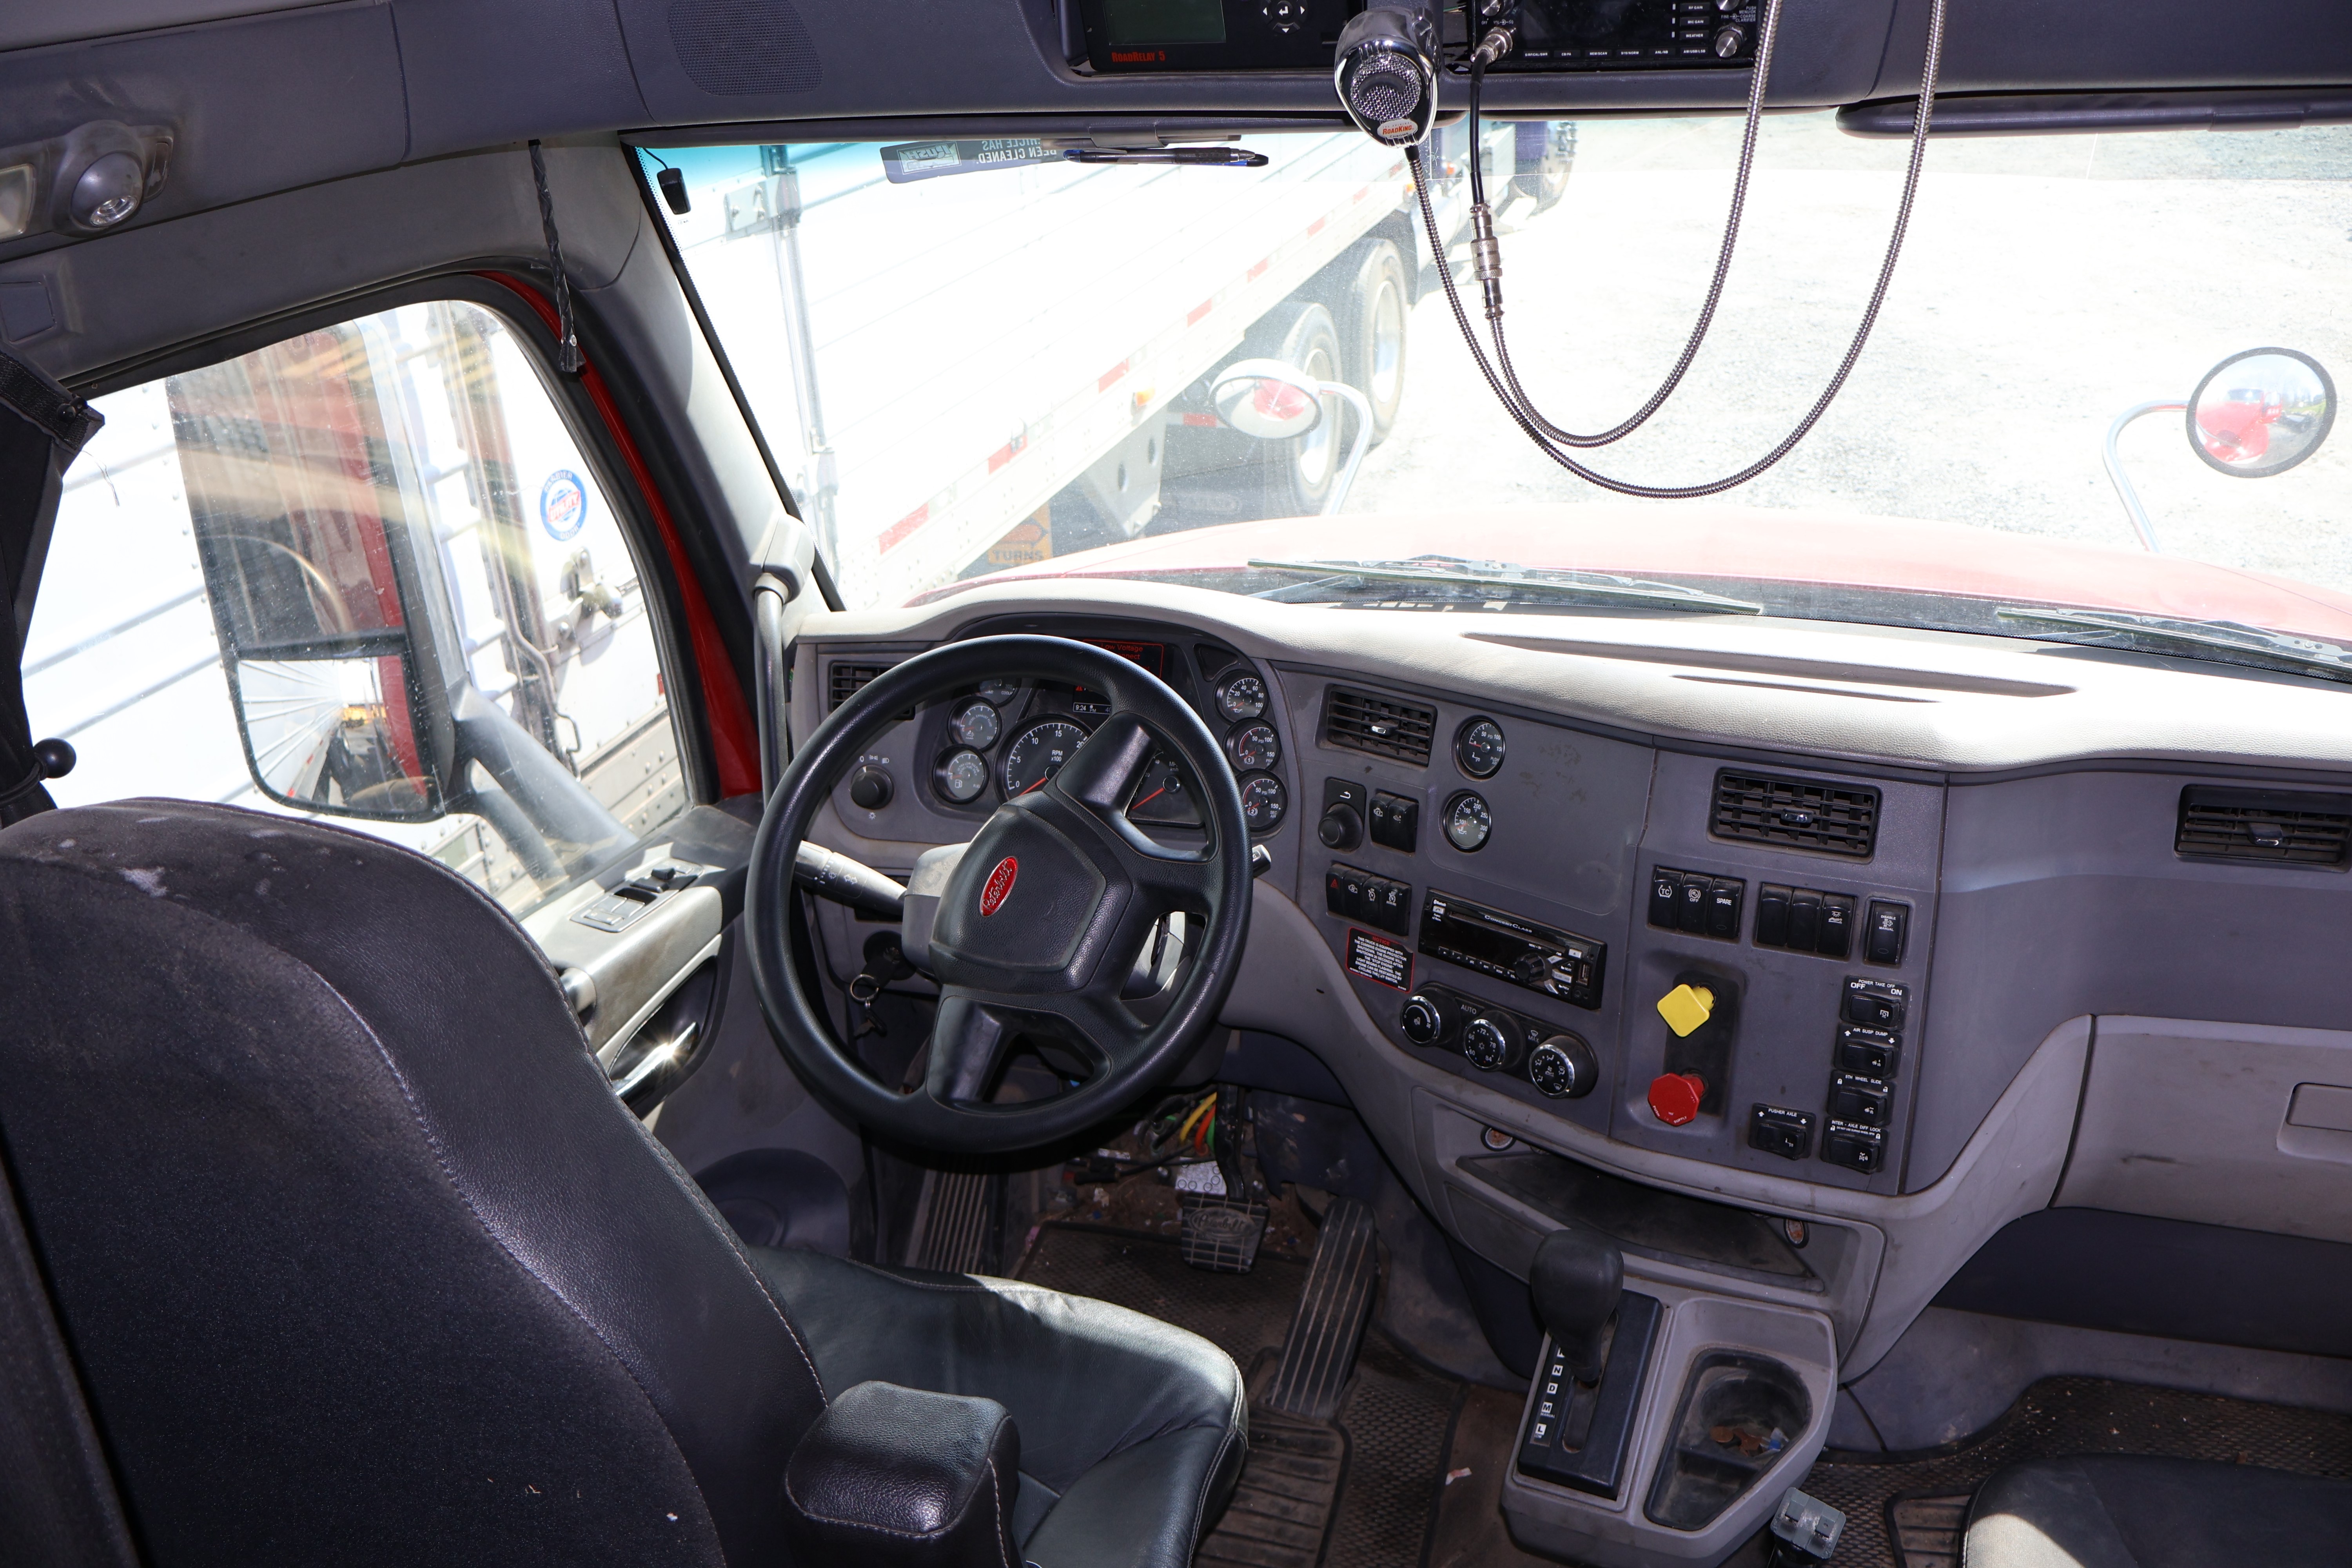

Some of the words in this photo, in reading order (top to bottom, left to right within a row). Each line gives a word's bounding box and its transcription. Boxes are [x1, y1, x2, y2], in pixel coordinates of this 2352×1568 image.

[1159, 51, 1165, 61] 5
[1118, 644, 1143, 652] Voltage
[982, 860, 1012, 911] Peterbilt
[1360, 942, 1375, 950] CUMMINS
[1387, 951, 1406, 961] PROTECTION
[1379, 944, 1394, 953] EQUIPPED
[1356, 948, 1374, 958] SHUTDOWN
[1378, 956, 1392, 965] SECONDS
[1379, 969, 1397, 979] RESTARTED
[1461, 1004, 1476, 1014] AUTO
